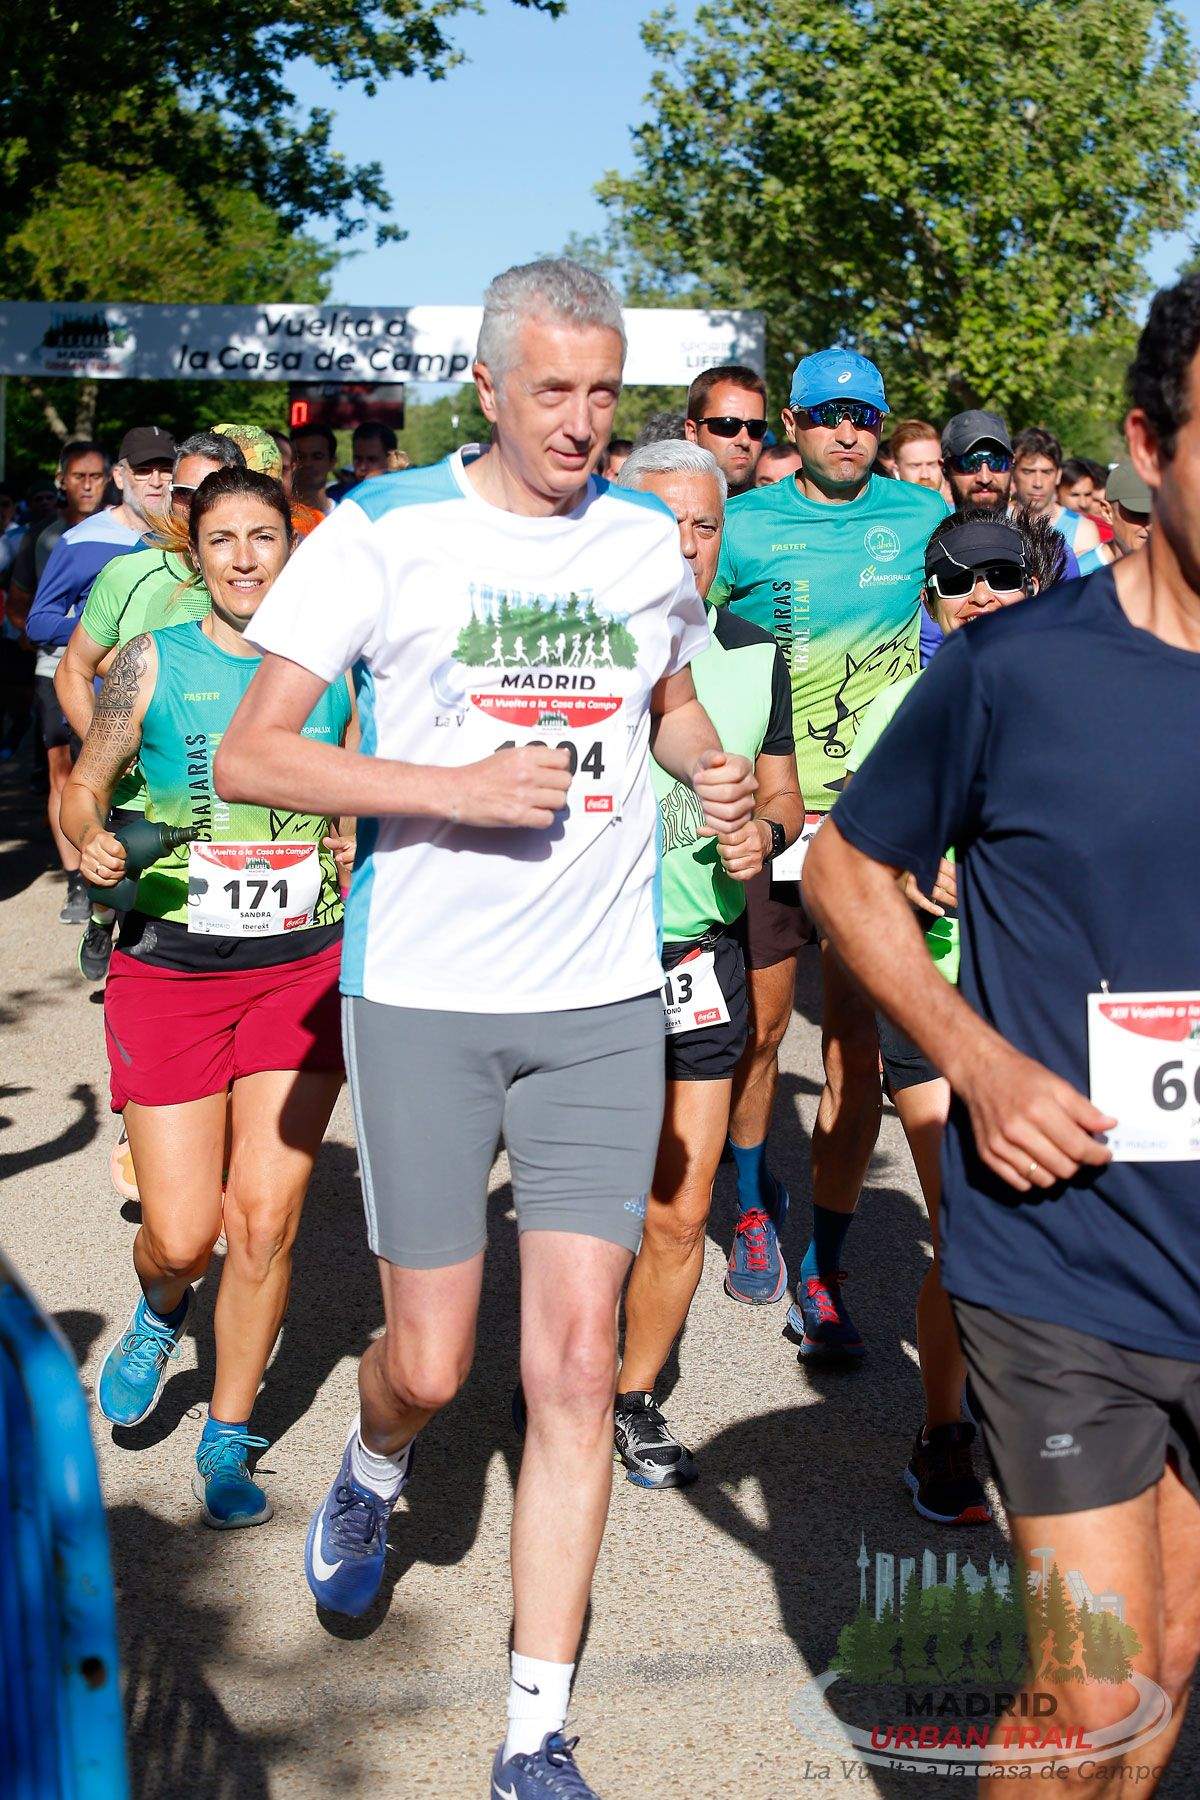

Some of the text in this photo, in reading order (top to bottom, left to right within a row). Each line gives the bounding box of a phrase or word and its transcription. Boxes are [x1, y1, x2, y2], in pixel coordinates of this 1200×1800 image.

[263, 311, 406, 337] Vuelta a
[179, 344, 209, 370] la
[218, 346, 302, 371] Casa
[315, 347, 356, 371] de
[771, 543, 807, 552] FASTER
[793, 579, 810, 623] TEAM
[501, 674, 596, 690] MADRID
[183, 691, 220, 701] FASTER
[495, 699, 528, 709] Vuelta
[551, 700, 574, 710] Casa
[587, 702, 617, 712] Campo
[213, 848, 237, 856] Vuelta
[224, 879, 288, 909] 171
[1131, 1006, 1174, 1019] Vuelta
